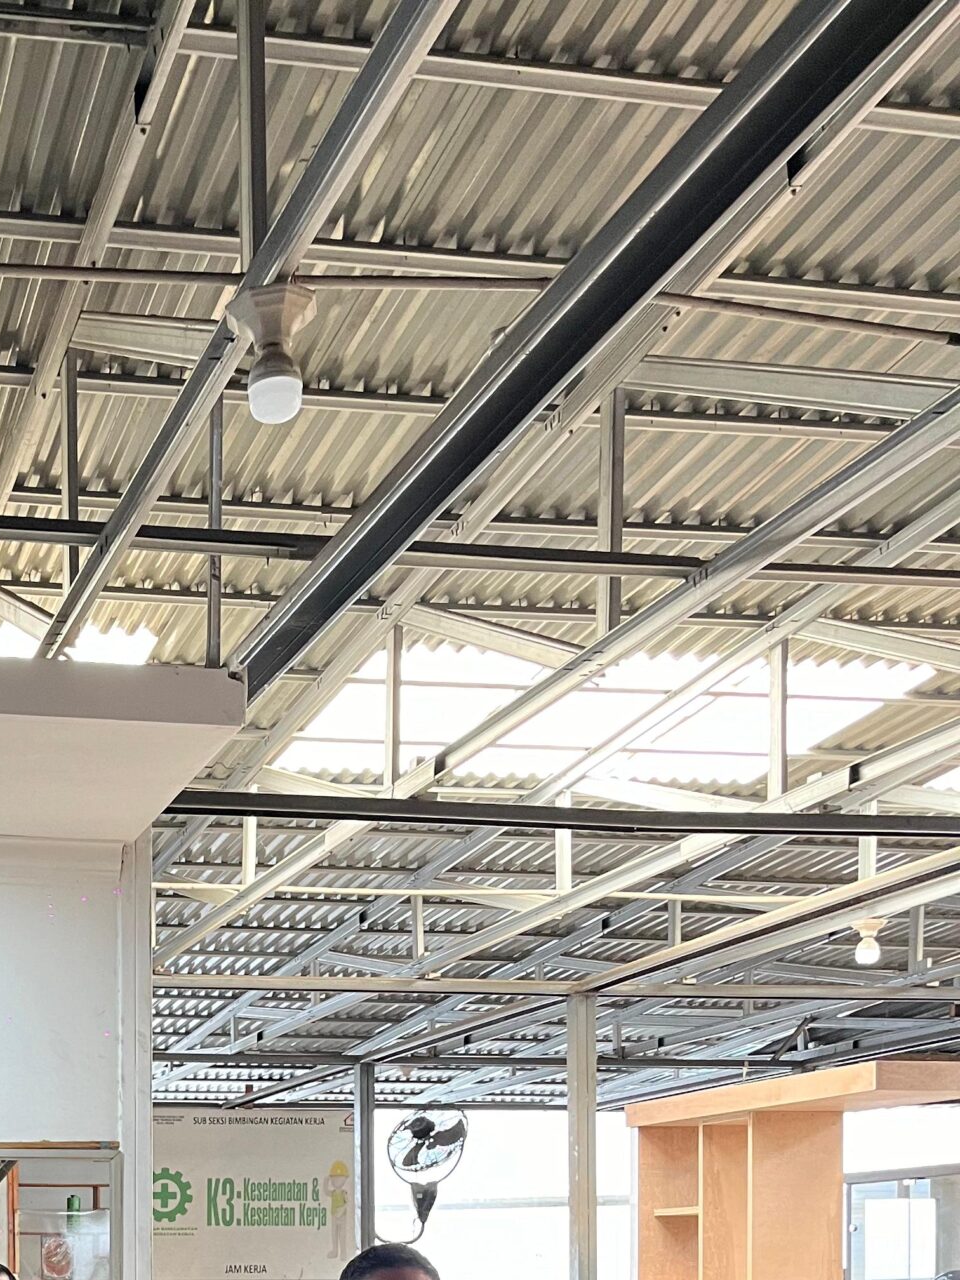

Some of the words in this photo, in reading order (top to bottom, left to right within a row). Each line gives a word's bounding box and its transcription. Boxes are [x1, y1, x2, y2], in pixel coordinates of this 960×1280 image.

[193, 1116, 207, 1125] SUB
[208, 1116, 227, 1125] SEKSI
[228, 1117, 269, 1126] BIMBINGAN
[270, 1117, 303, 1126] KEGIATAN
[304, 1117, 325, 1126] KERJA
[243, 1177, 308, 1202] Keselamatan
[311, 1177, 320, 1202] &
[243, 1203, 296, 1227] Kesehatan
[299, 1203, 327, 1230] Kerja
[225, 1264, 242, 1274] JAM
[243, 1264, 267, 1274] KERJA
